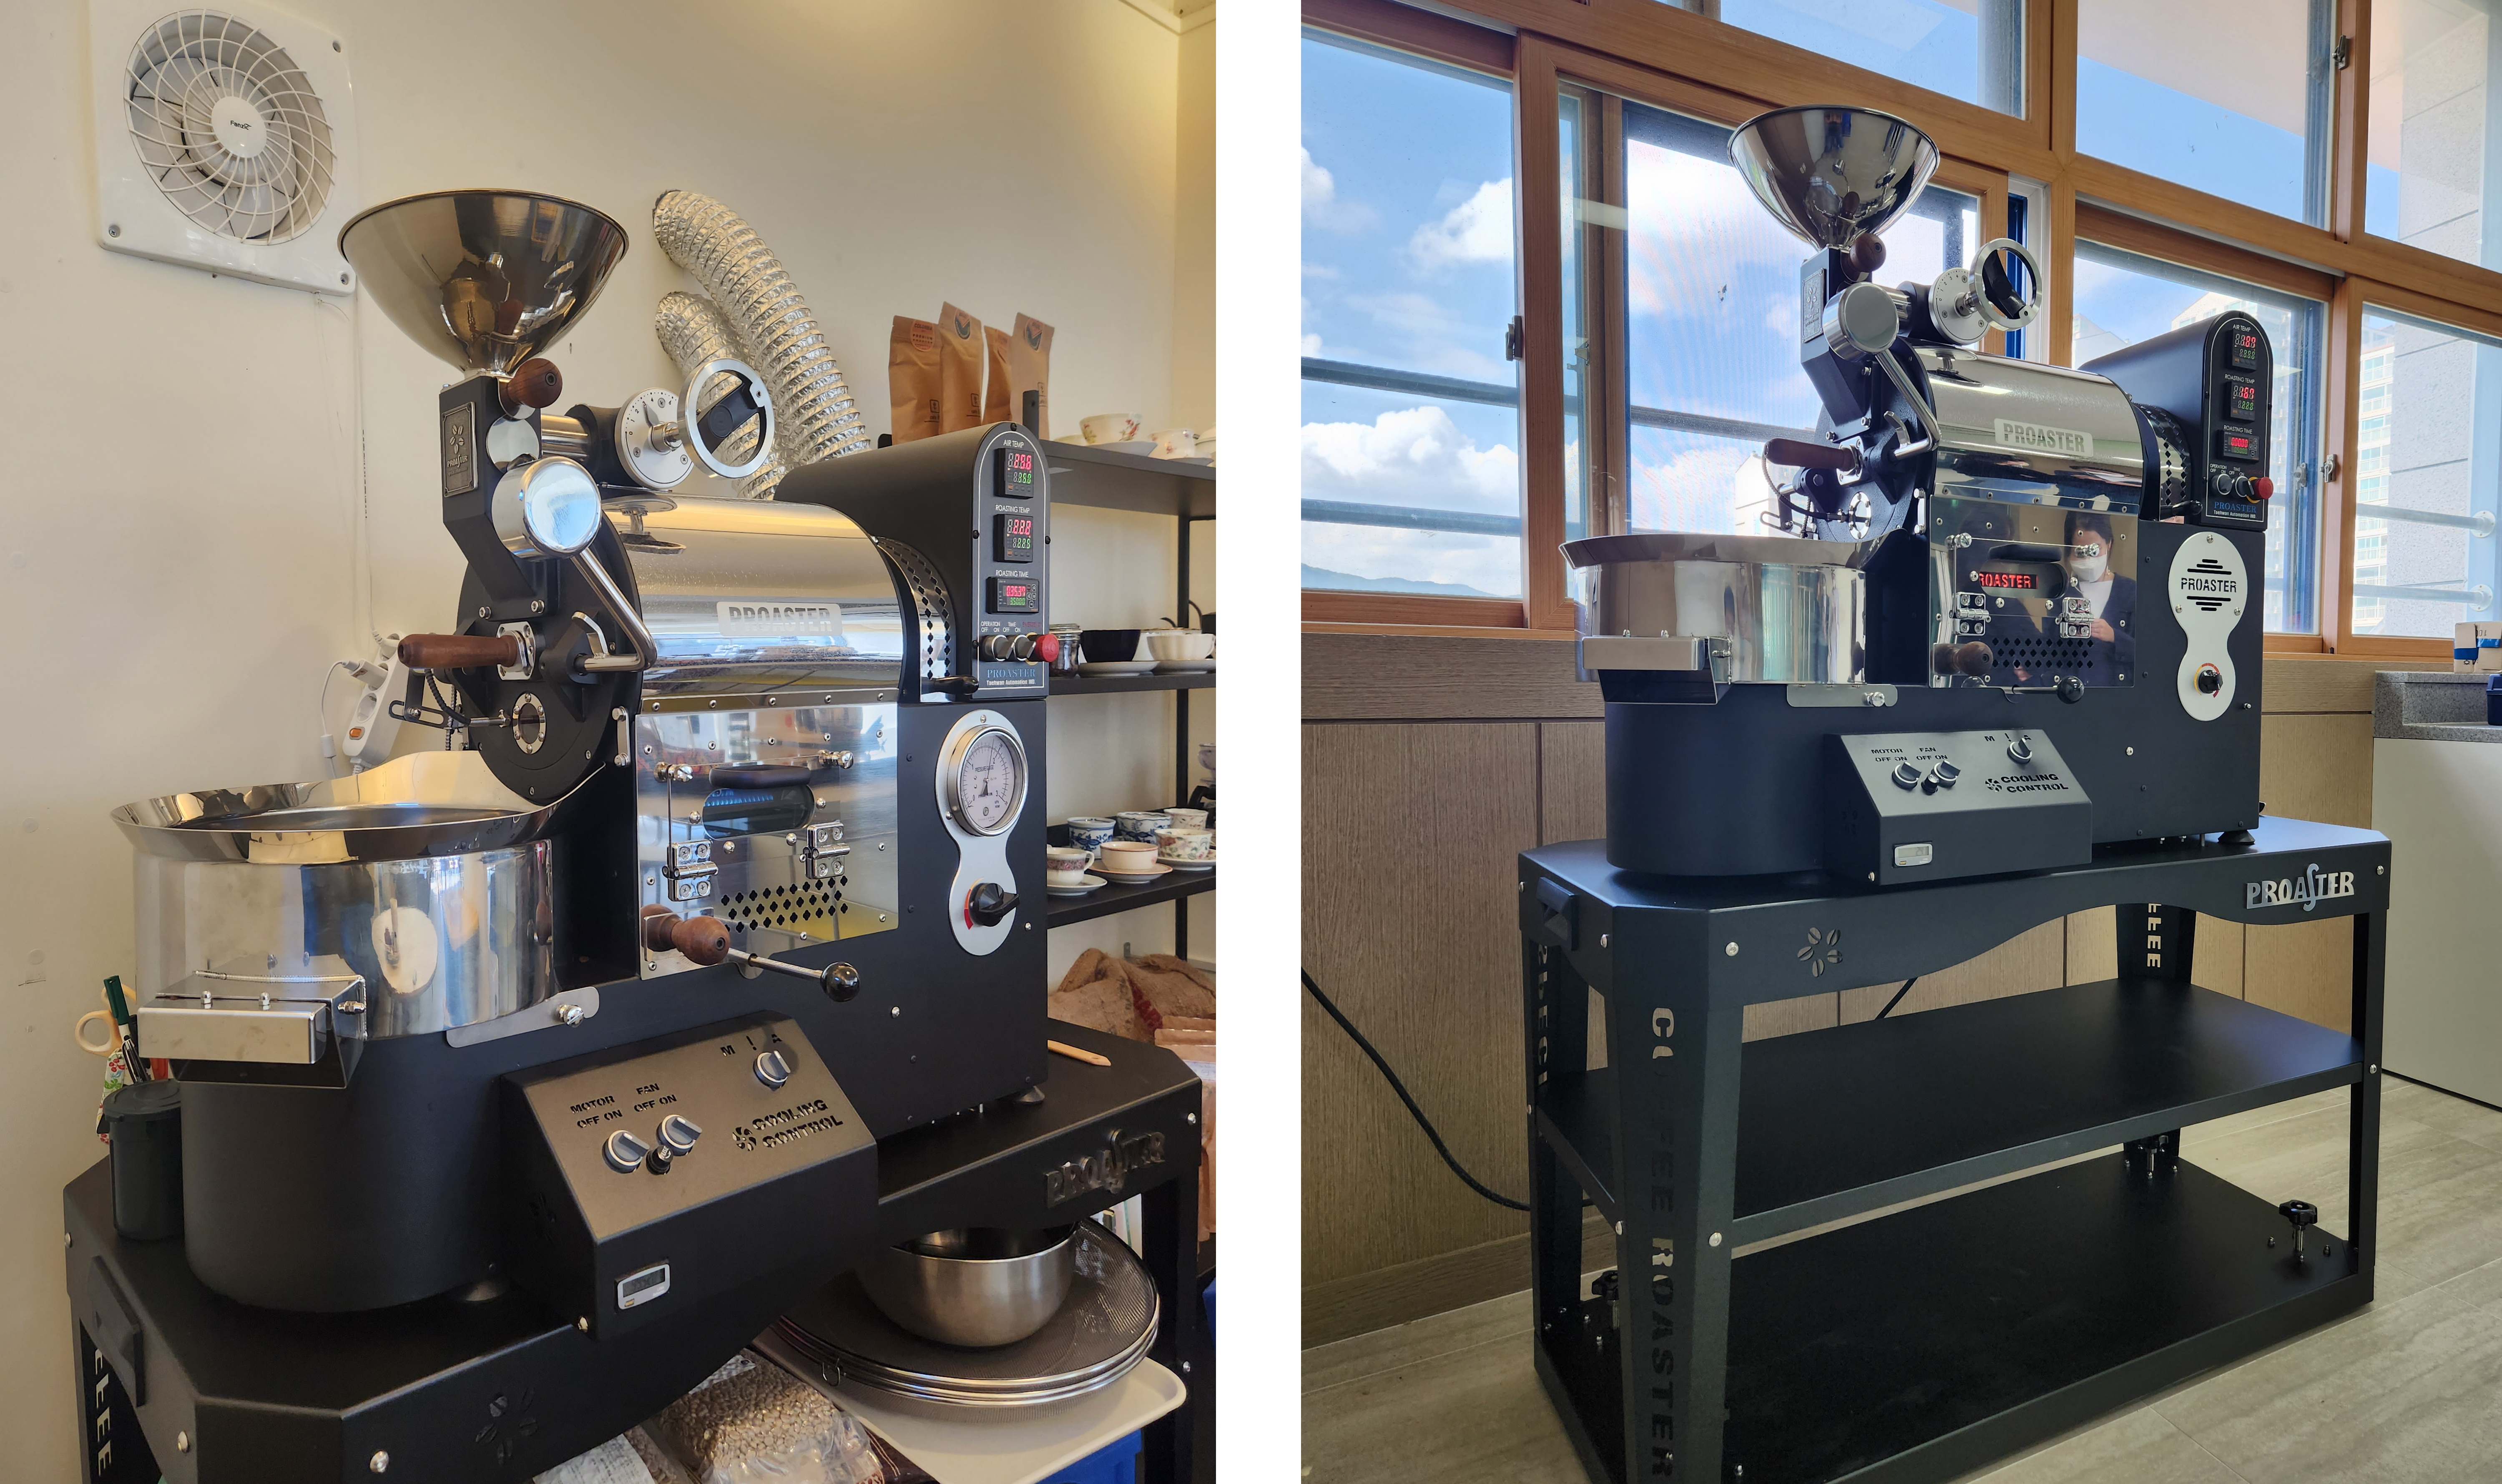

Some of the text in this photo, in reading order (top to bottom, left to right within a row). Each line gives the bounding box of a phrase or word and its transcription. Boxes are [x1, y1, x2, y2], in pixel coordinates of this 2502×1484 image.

[230, 120, 252, 130] Fanzic
[2003, 422, 2085, 452] PROASTER
[447, 454, 467, 468] PROASTER
[2214, 502, 2256, 513] PROASTER
[2181, 577, 2237, 593] PROASTER
[728, 607, 832, 632] PROASTER
[987, 669, 1035, 678] PROASTER
[2001, 773, 2059, 783] COOLING
[2007, 783, 2068, 793] CONTROL
[2246, 863, 2354, 911] PROASTER
[720, 1045, 736, 1057] M
[771, 1034, 782, 1043] A
[636, 1083, 660, 1095] FAN
[570, 1095, 615, 1114] MOTOR
[634, 1094, 677, 1112] OFF ON
[577, 1110, 623, 1128] OFF ON
[752, 1100, 828, 1130] COOLING
[762, 1115, 844, 1148] CONTROL
